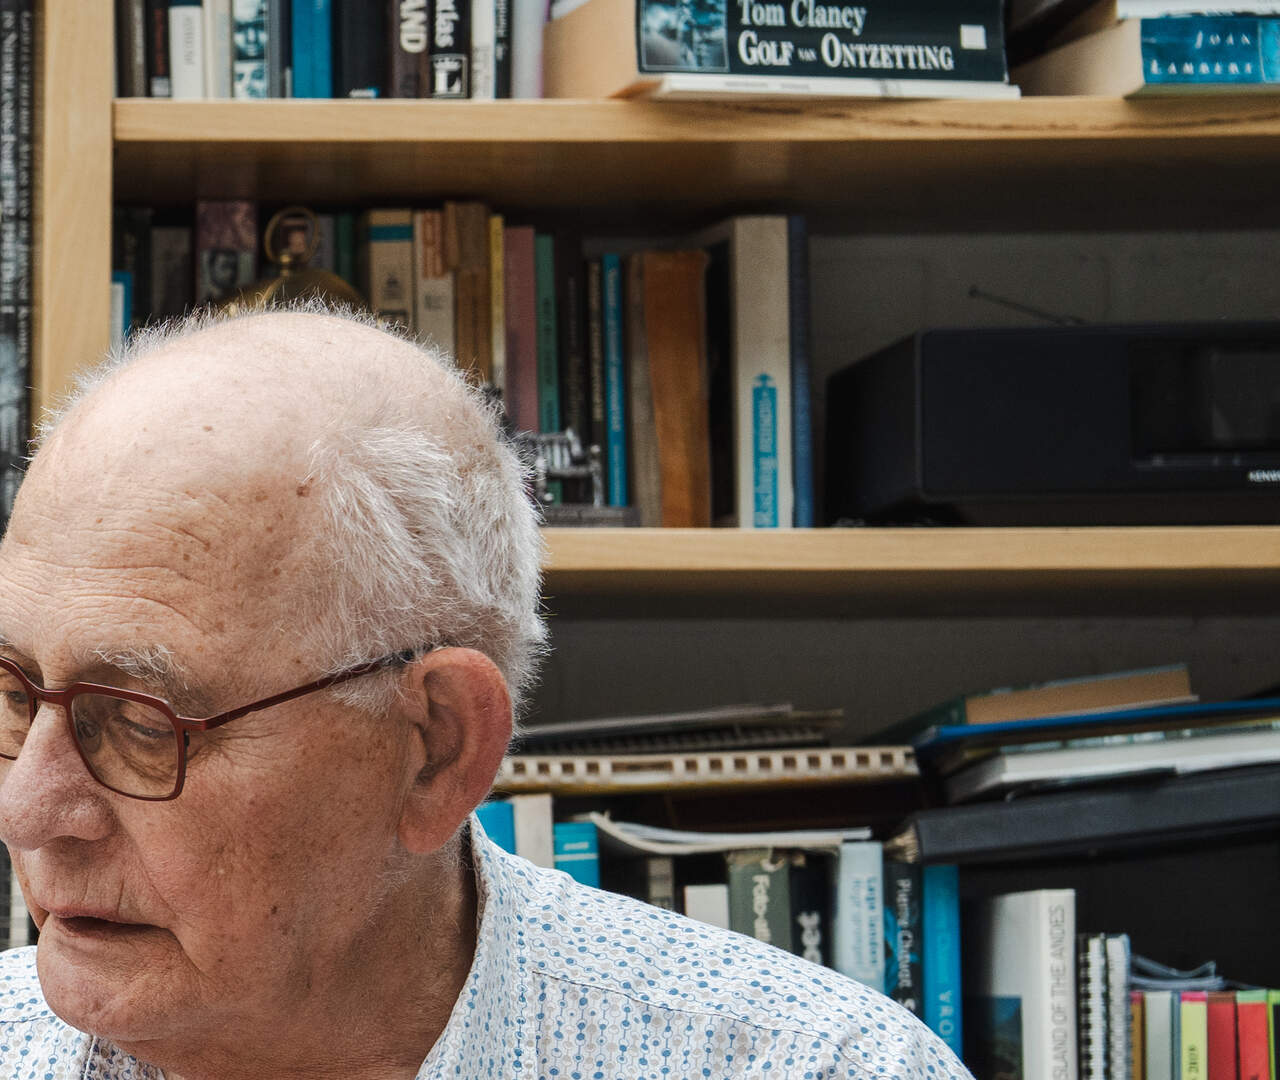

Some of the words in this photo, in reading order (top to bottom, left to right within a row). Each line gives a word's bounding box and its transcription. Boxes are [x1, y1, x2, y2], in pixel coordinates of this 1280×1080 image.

[738, 0, 786, 26] Tom
[791, 0, 867, 36] Clancy
[1149, 59, 1253, 75] LAMBERT
[1048, 904, 1066, 960] ANDES
[1050, 961, 1067, 999] THE
[1051, 1003, 1068, 1026] OF
